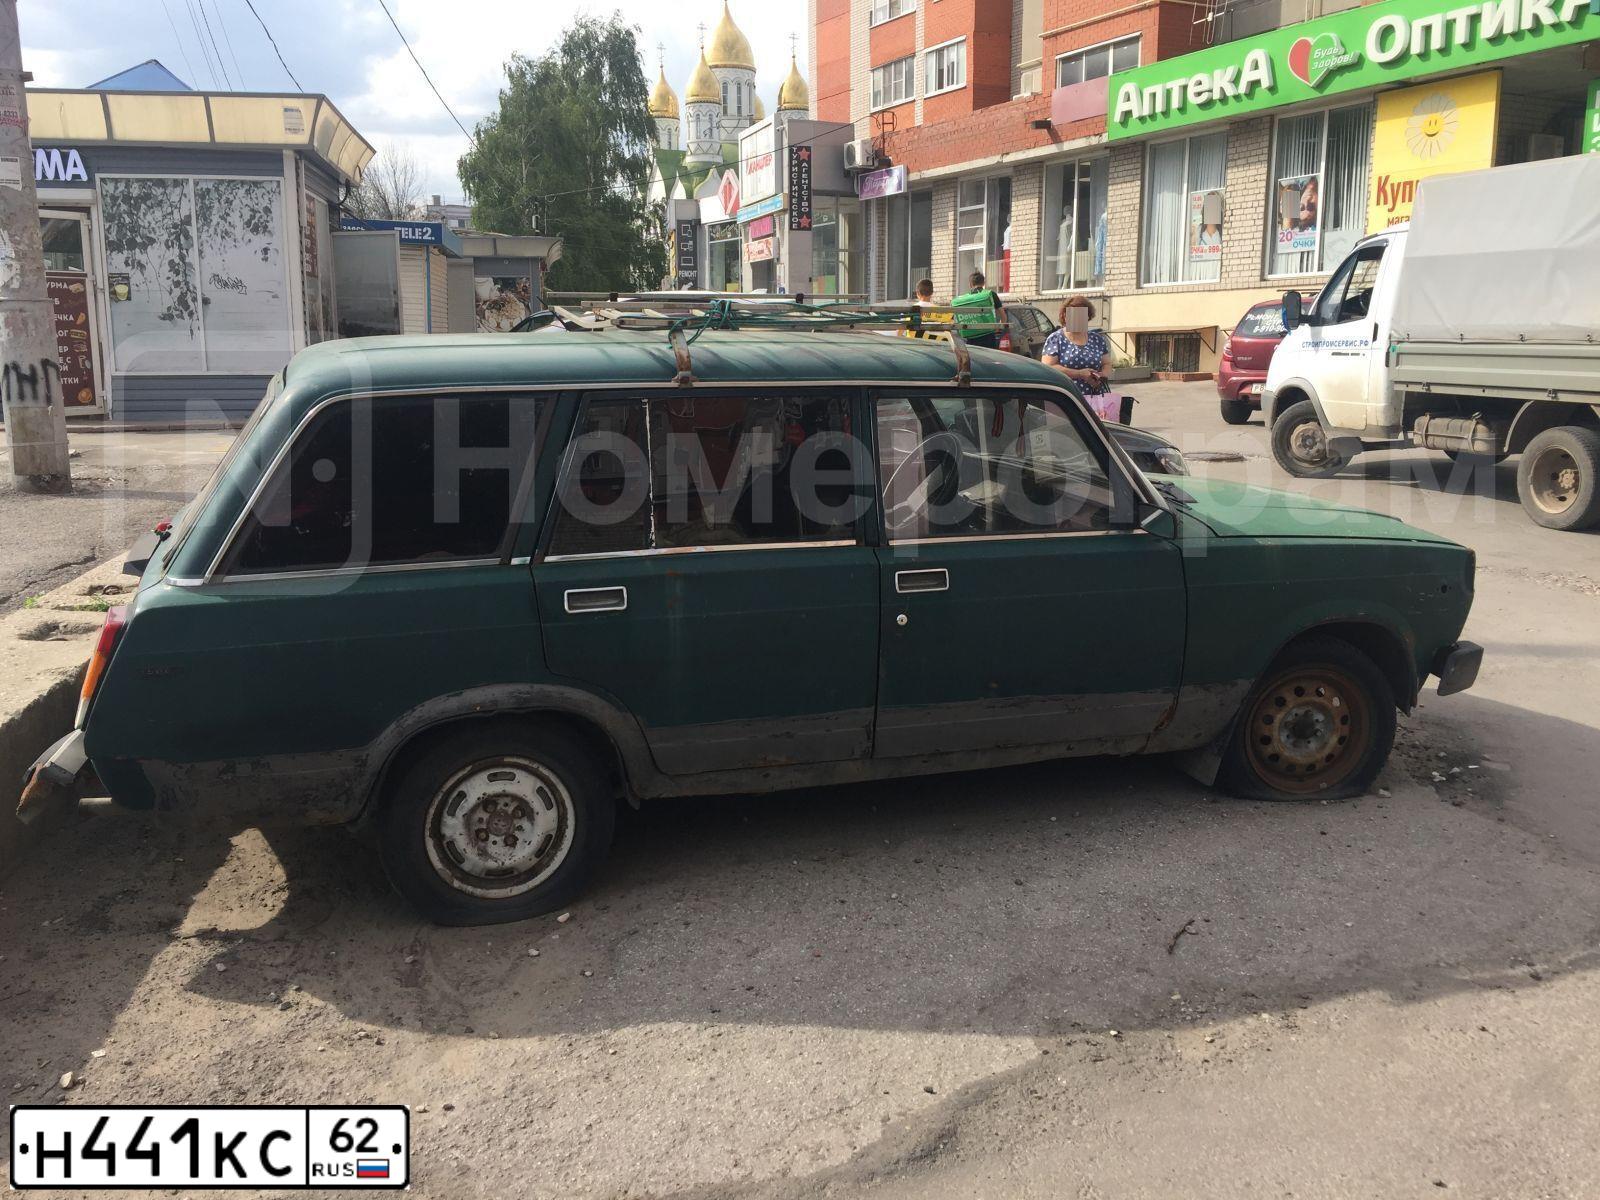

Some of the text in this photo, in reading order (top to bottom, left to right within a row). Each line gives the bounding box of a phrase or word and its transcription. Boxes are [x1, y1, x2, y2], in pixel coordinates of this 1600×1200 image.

[1312, 52, 1354, 70] здоров!
[1314, 48, 1339, 59] Будь
[1114, 49, 1272, 123] АптекА
[33, 148, 88, 181] МА
[791, 146, 799, 230] ТУРИСТИЧЕСКОЕ
[801, 162, 809, 213] АГЕНТСТВО
[1376, 174, 1420, 213] Куп
[678, 270, 698, 278] РЕМОНТ
